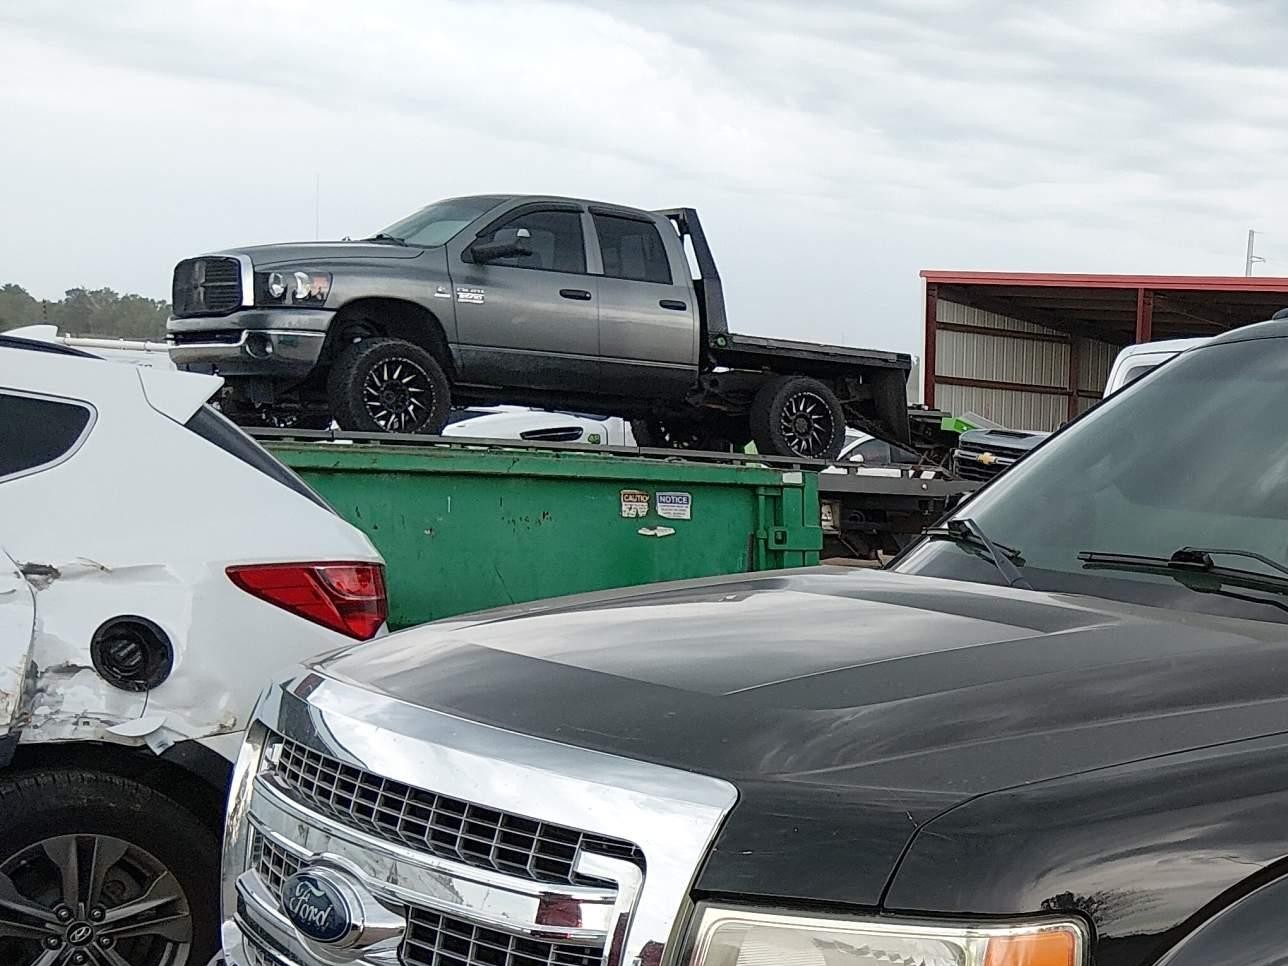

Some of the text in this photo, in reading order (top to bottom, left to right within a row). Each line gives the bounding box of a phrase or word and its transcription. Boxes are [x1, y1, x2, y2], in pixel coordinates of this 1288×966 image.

[624, 494, 649, 503] CAUTIO
[659, 496, 688, 504] NOTICE
[289, 880, 333, 927] Ford
